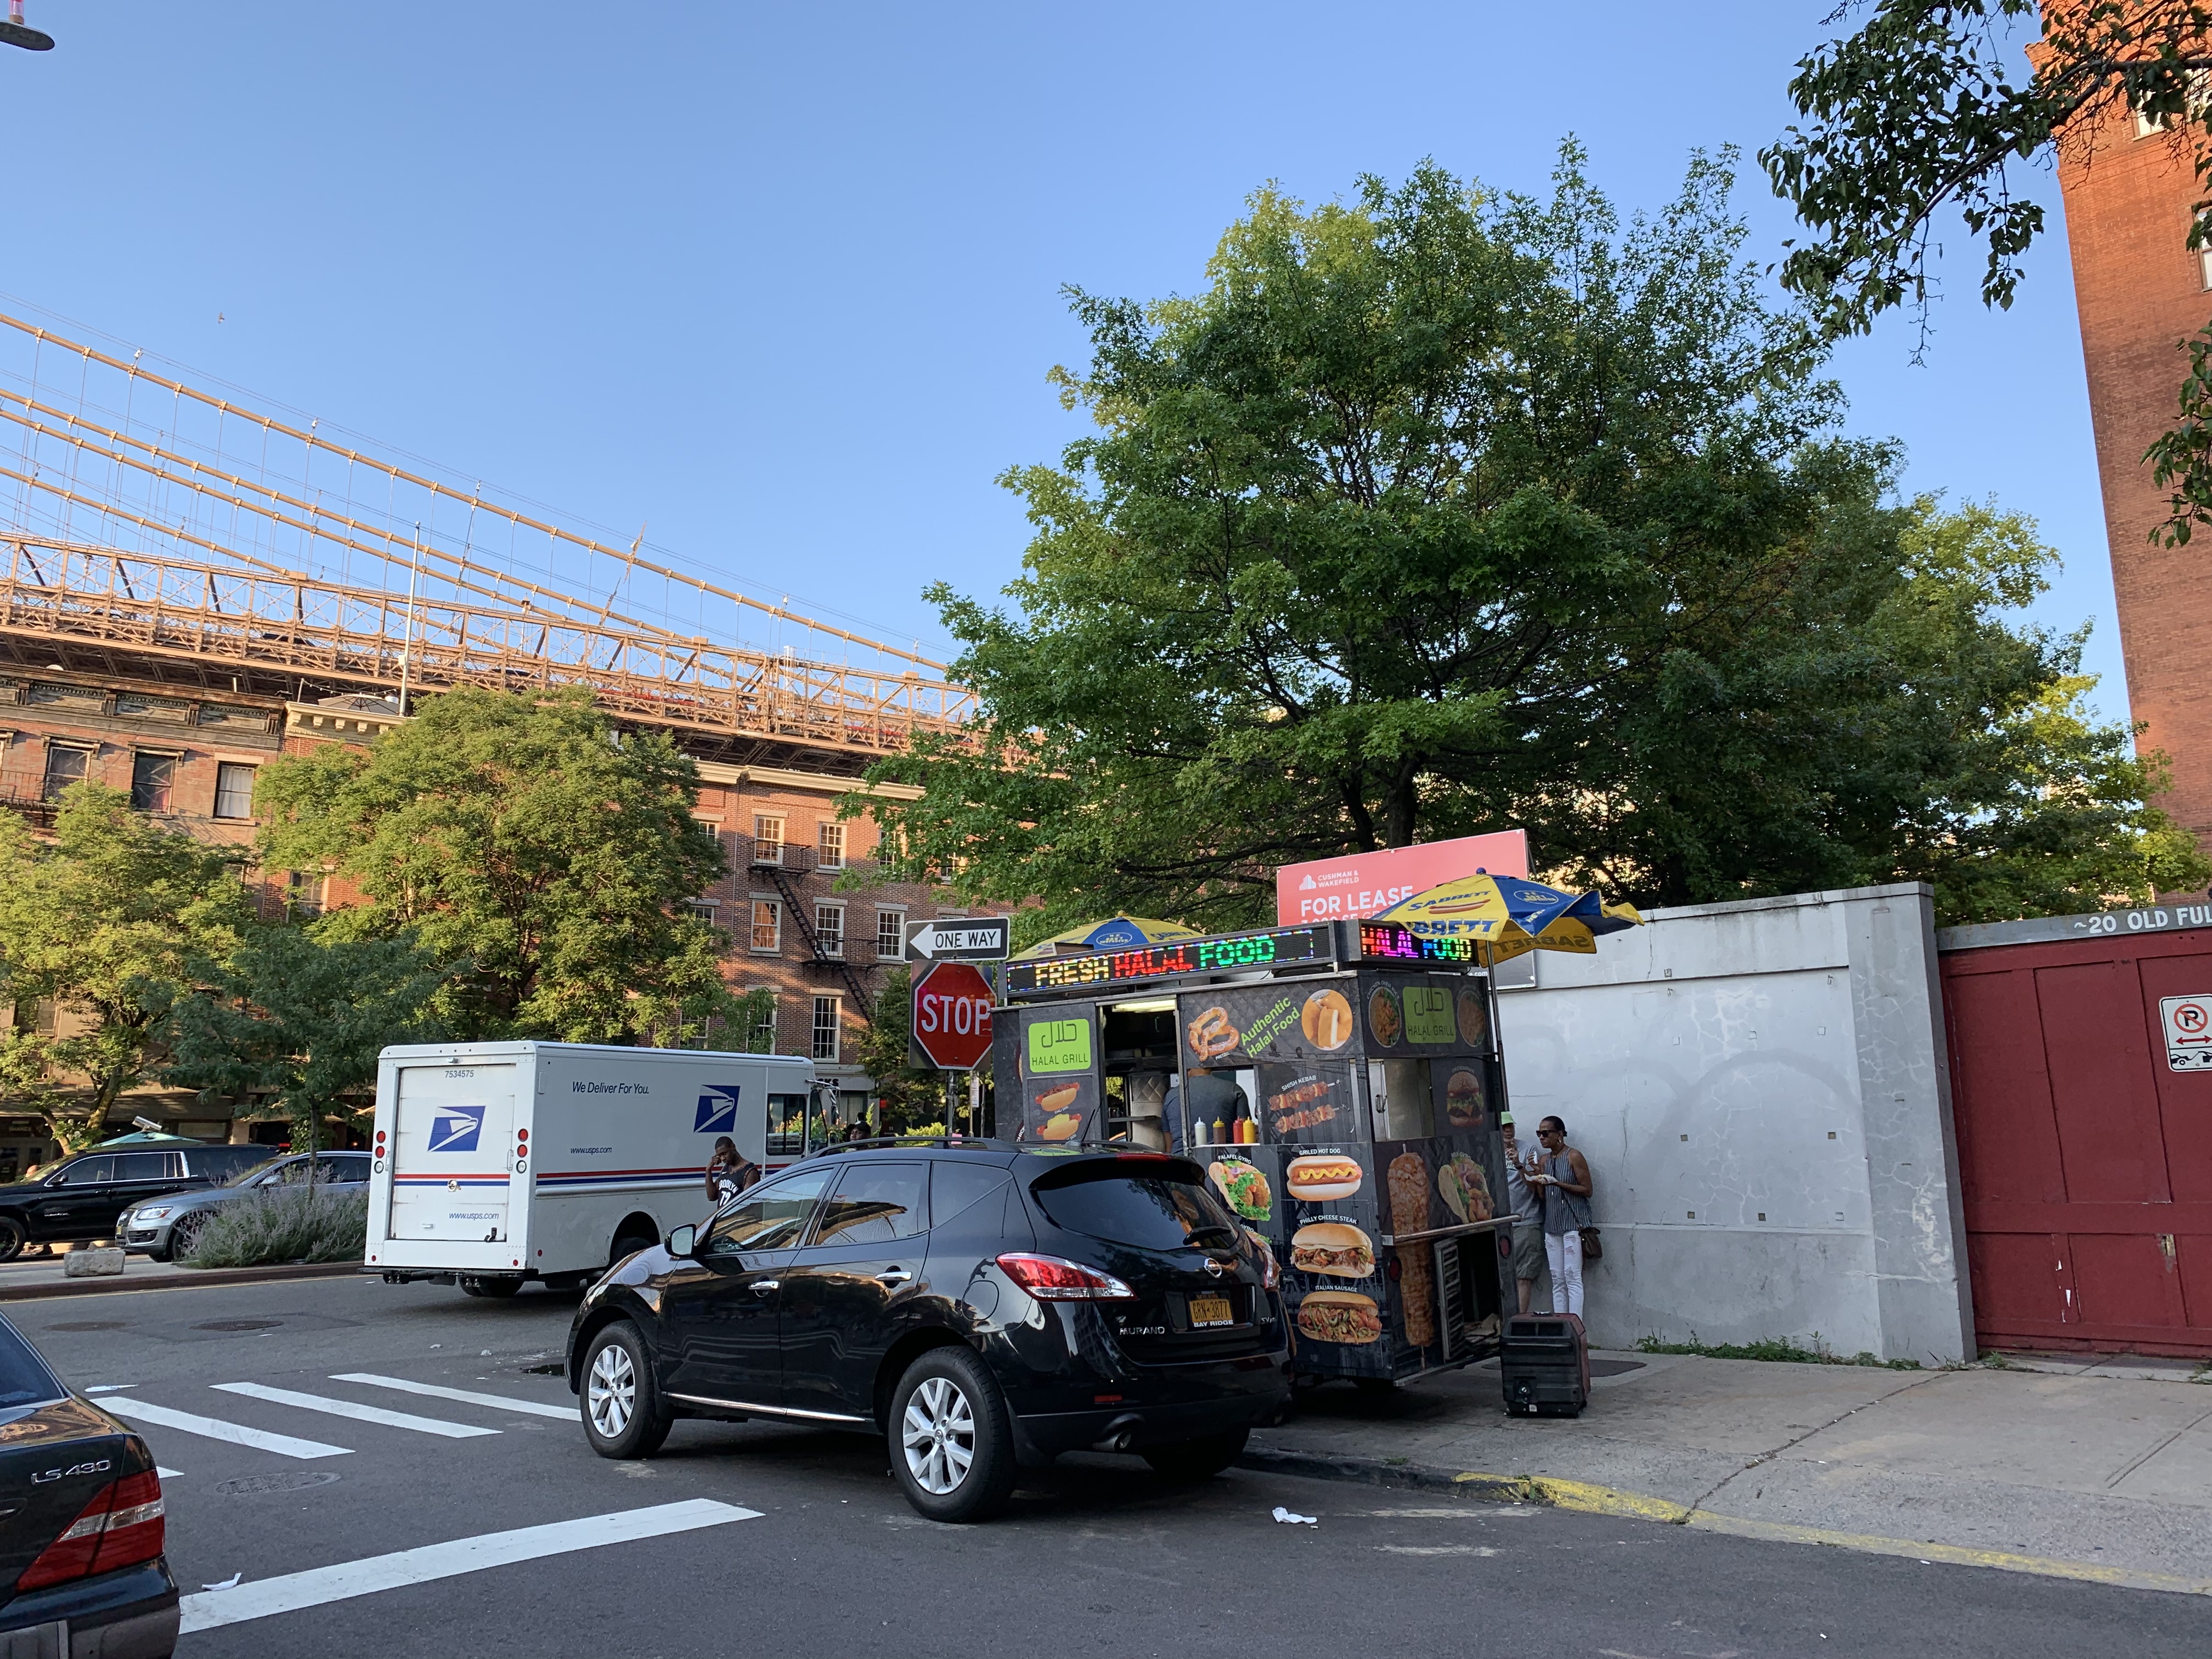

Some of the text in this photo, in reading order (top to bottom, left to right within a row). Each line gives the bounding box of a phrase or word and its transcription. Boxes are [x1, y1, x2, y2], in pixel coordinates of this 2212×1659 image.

[1318, 871, 1352, 881] CUSHMAN
[1318, 877, 1359, 888] WAKEFIELD
[1301, 885, 1413, 917] FOR LEASE
[1407, 890, 1491, 911] SABRETT
[1410, 918, 1499, 936] BRETT
[2128, 911, 2168, 930] OLD
[935, 931, 997, 948] ONE WAY
[1361, 927, 1472, 961] HALAL FOOD
[1035, 939, 1274, 987] FRESH HALAL FOOD
[921, 994, 991, 1035] STOP
[1240, 997, 1291, 1046] Authentic
[1246, 1007, 1300, 1059] Halal Food
[1408, 1025, 1454, 1036] HALAL GRILL
[1032, 1053, 1088, 1066] HALAL GRILL
[1215, 1052, 1230, 1060] PRETZEL
[445, 1070, 474, 1078] 7534575
[573, 1081, 650, 1094] We Deliver For You.
[1282, 1075, 1317, 1091] SHISH KEBAB
[570, 1147, 612, 1155] www.usps.com
[1238, 1155, 1251, 1165] GYRO
[449, 1211, 499, 1221] www.usps.com
[1300, 1216, 1318, 1225] PHILLY
[1339, 1216, 1357, 1224] STEAK
[1240, 1224, 1254, 1233] GYRO
[1120, 1326, 1165, 1335] MURANO
[31, 1459, 111, 1485] LS 430
